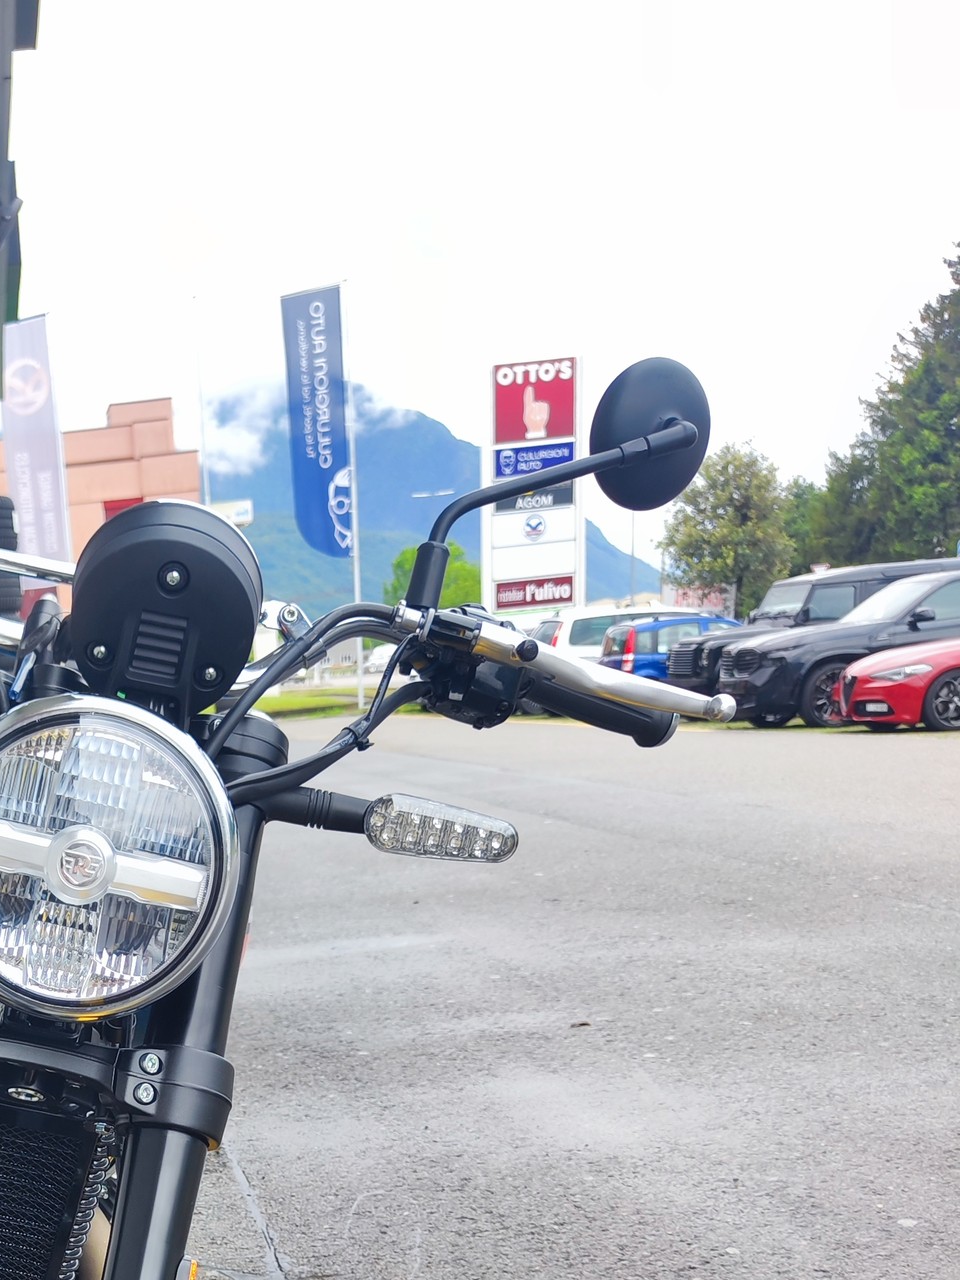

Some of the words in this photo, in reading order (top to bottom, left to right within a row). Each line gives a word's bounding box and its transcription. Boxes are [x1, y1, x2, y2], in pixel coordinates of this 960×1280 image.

[496, 360, 573, 386] OTTO'S
[517, 461, 543, 471] AUTO
[515, 493, 554, 510] AGOM
